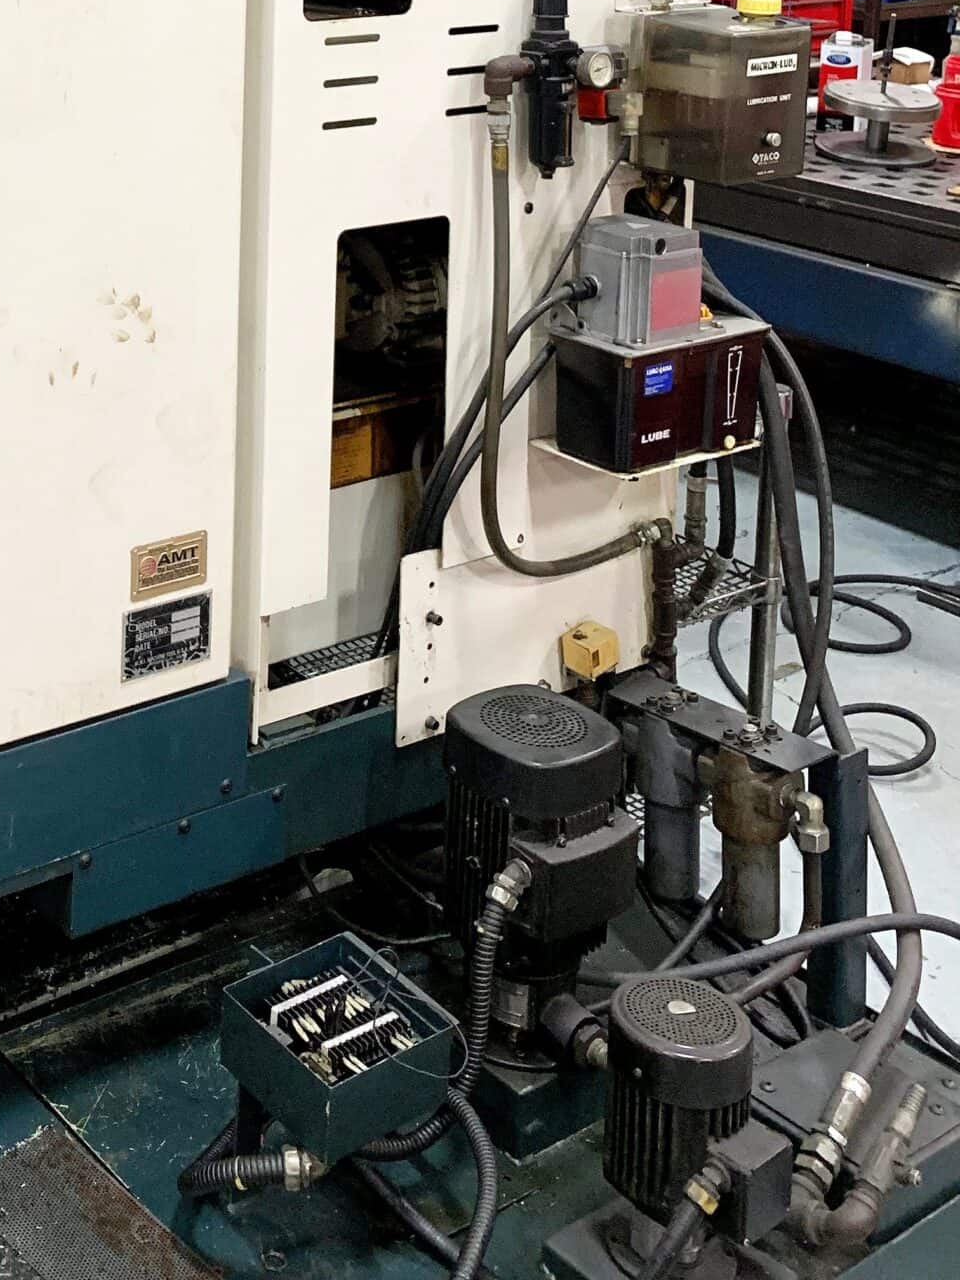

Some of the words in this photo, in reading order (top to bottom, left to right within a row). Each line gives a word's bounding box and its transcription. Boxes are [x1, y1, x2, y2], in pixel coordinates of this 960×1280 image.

[759, 151, 780, 162] TACO
[641, 428, 671, 444] LUBE
[157, 545, 199, 567] AMT
